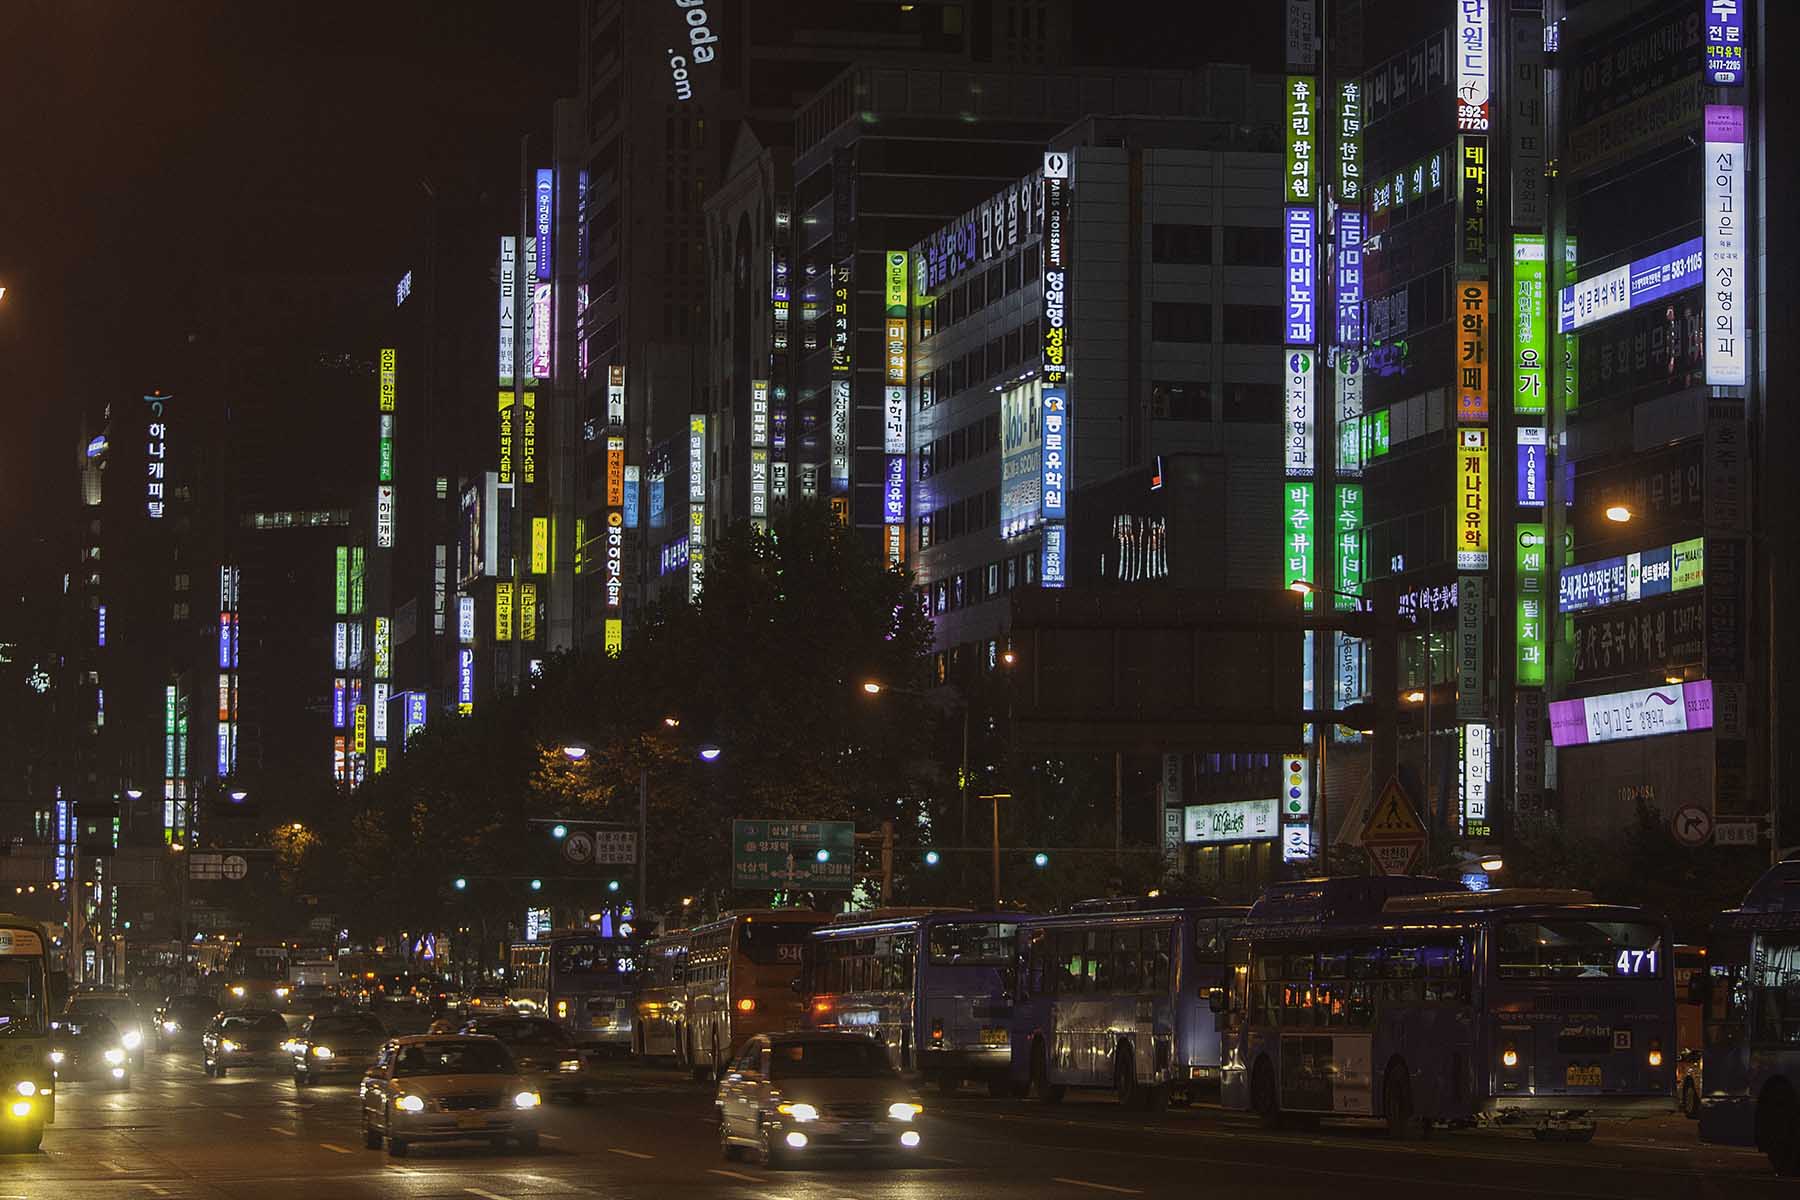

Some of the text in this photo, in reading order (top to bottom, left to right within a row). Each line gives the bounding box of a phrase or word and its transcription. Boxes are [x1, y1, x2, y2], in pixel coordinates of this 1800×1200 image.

[667, 48, 692, 100] .com
[1459, 105, 1488, 130] 592- 7720
[1292, 82, 1312, 198] 휴그린 한의원
[1465, 147, 1485, 185] 테마
[1050, 179, 1061, 266] PARIS CROISSANT
[1716, 153, 1733, 236] 신이고은
[1289, 210, 1312, 342] 프리마비뇨기과
[1716, 267, 1735, 358] 성형외과
[1462, 287, 1484, 391] 유학카페
[1519, 348, 1542, 398] 요가
[148, 423, 166, 518] 하나캐피탈
[1465, 457, 1482, 548] 캐나다유학
[1290, 486, 1310, 578] 박준뷰티
[1522, 553, 1540, 665] 센트럴치과
[1471, 728, 1484, 816] 이비인후과
[1616, 950, 1658, 974] 471
